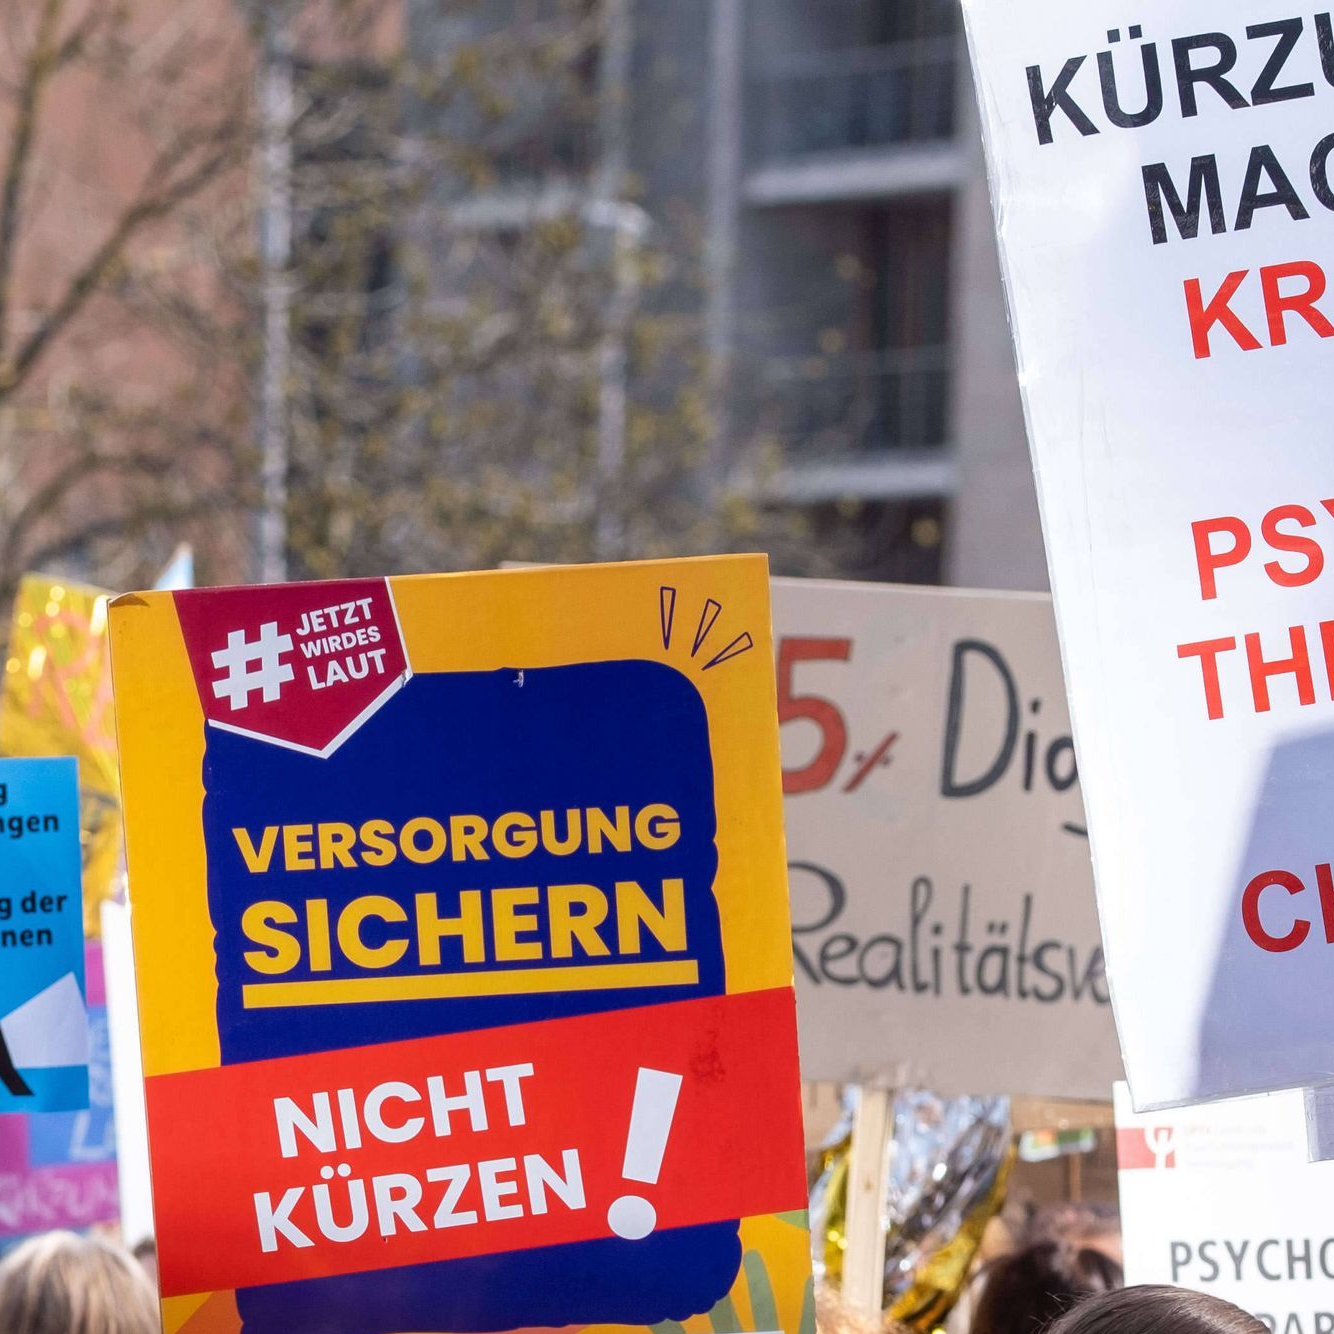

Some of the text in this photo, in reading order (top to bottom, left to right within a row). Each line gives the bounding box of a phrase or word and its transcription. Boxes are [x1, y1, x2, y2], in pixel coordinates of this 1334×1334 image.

[296, 597, 373, 637] JETZT
[308, 649, 387, 690] LAUT
[232, 803, 681, 874] VERSORGUNG
[22, 891, 68, 915] der
[241, 878, 688, 976] SICHERN
[273, 1062, 535, 1159] NICHT
[253, 1147, 587, 1254] KÜRZEN
